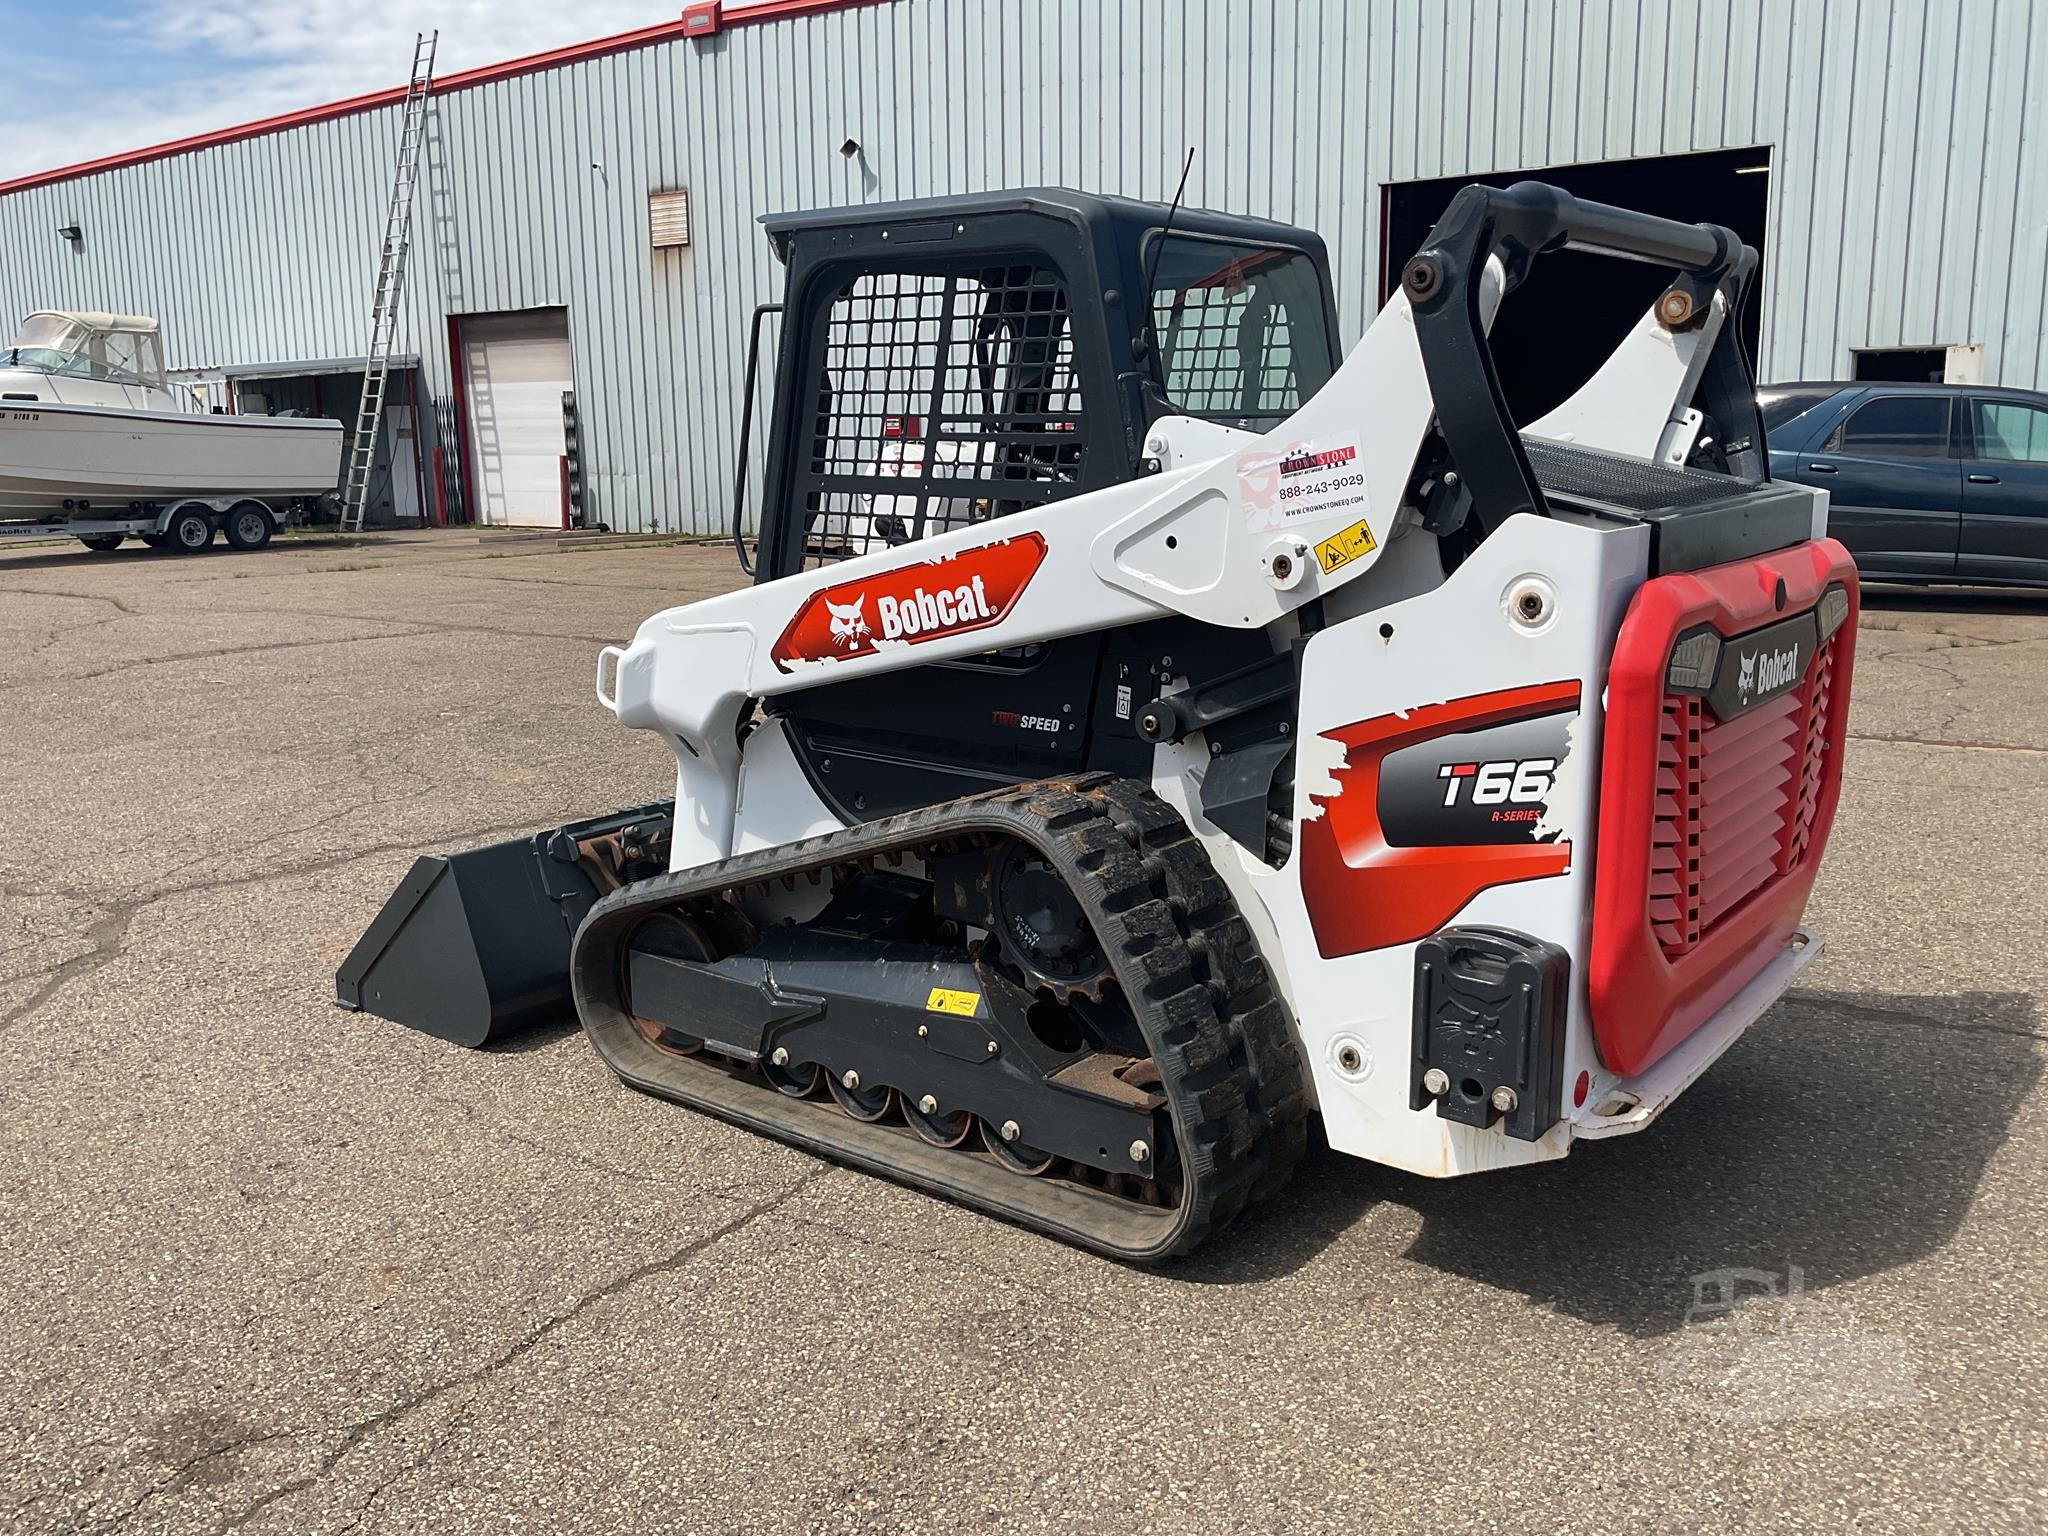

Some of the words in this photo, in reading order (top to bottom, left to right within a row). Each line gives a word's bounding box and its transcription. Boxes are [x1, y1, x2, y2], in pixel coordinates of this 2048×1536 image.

[1281, 448, 1353, 474] CROWNSTONE
[1280, 474, 1364, 500] 888-243-9029
[1285, 495, 1364, 517] WWW.CROWNSTONEEQ.COM
[877, 575, 991, 640] Bobcat
[1757, 642, 1798, 695] Bobcat
[1020, 715, 1060, 732] SPEED
[1439, 758, 1556, 807] T66
[1491, 809, 1541, 822] R-SERIES
